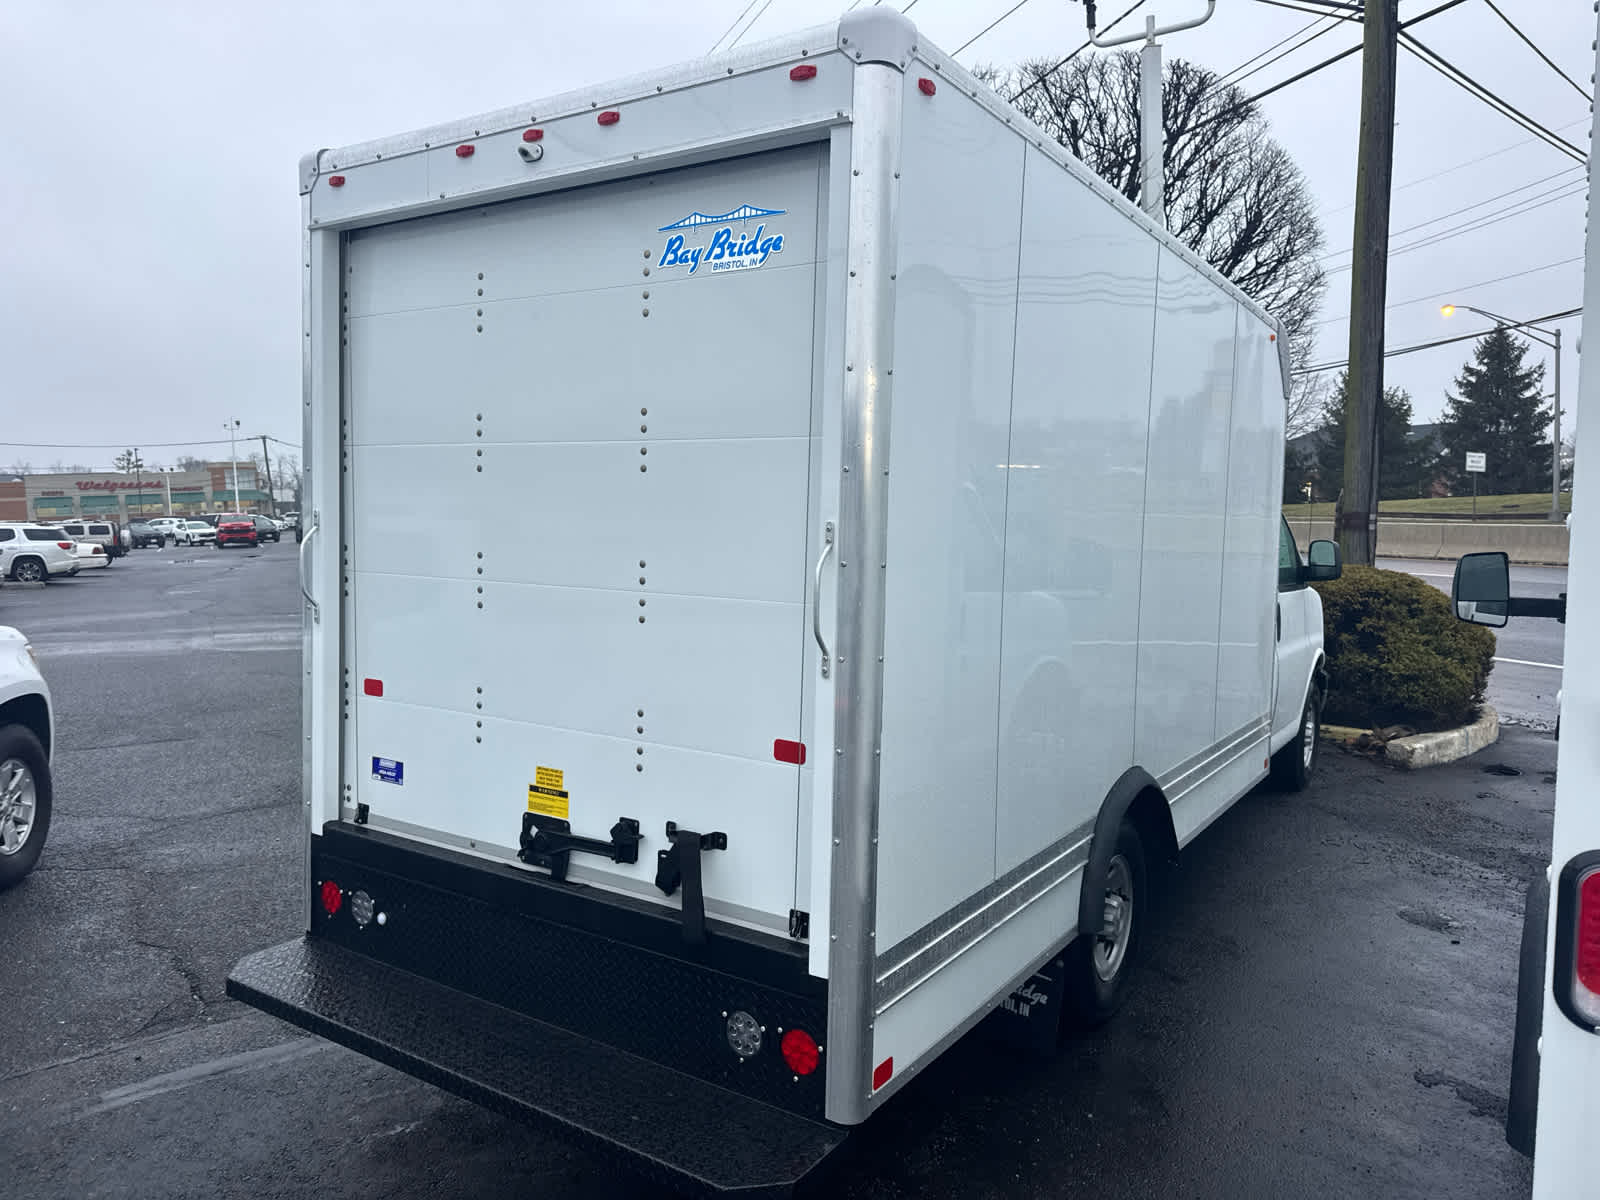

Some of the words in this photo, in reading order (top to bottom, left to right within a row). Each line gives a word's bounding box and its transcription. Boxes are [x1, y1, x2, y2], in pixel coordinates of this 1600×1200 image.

[658, 234, 703, 274] Bay
[703, 224, 784, 265] Bridge
[749, 258, 758, 267] IN
[75, 480, 164, 493] Walgreens
